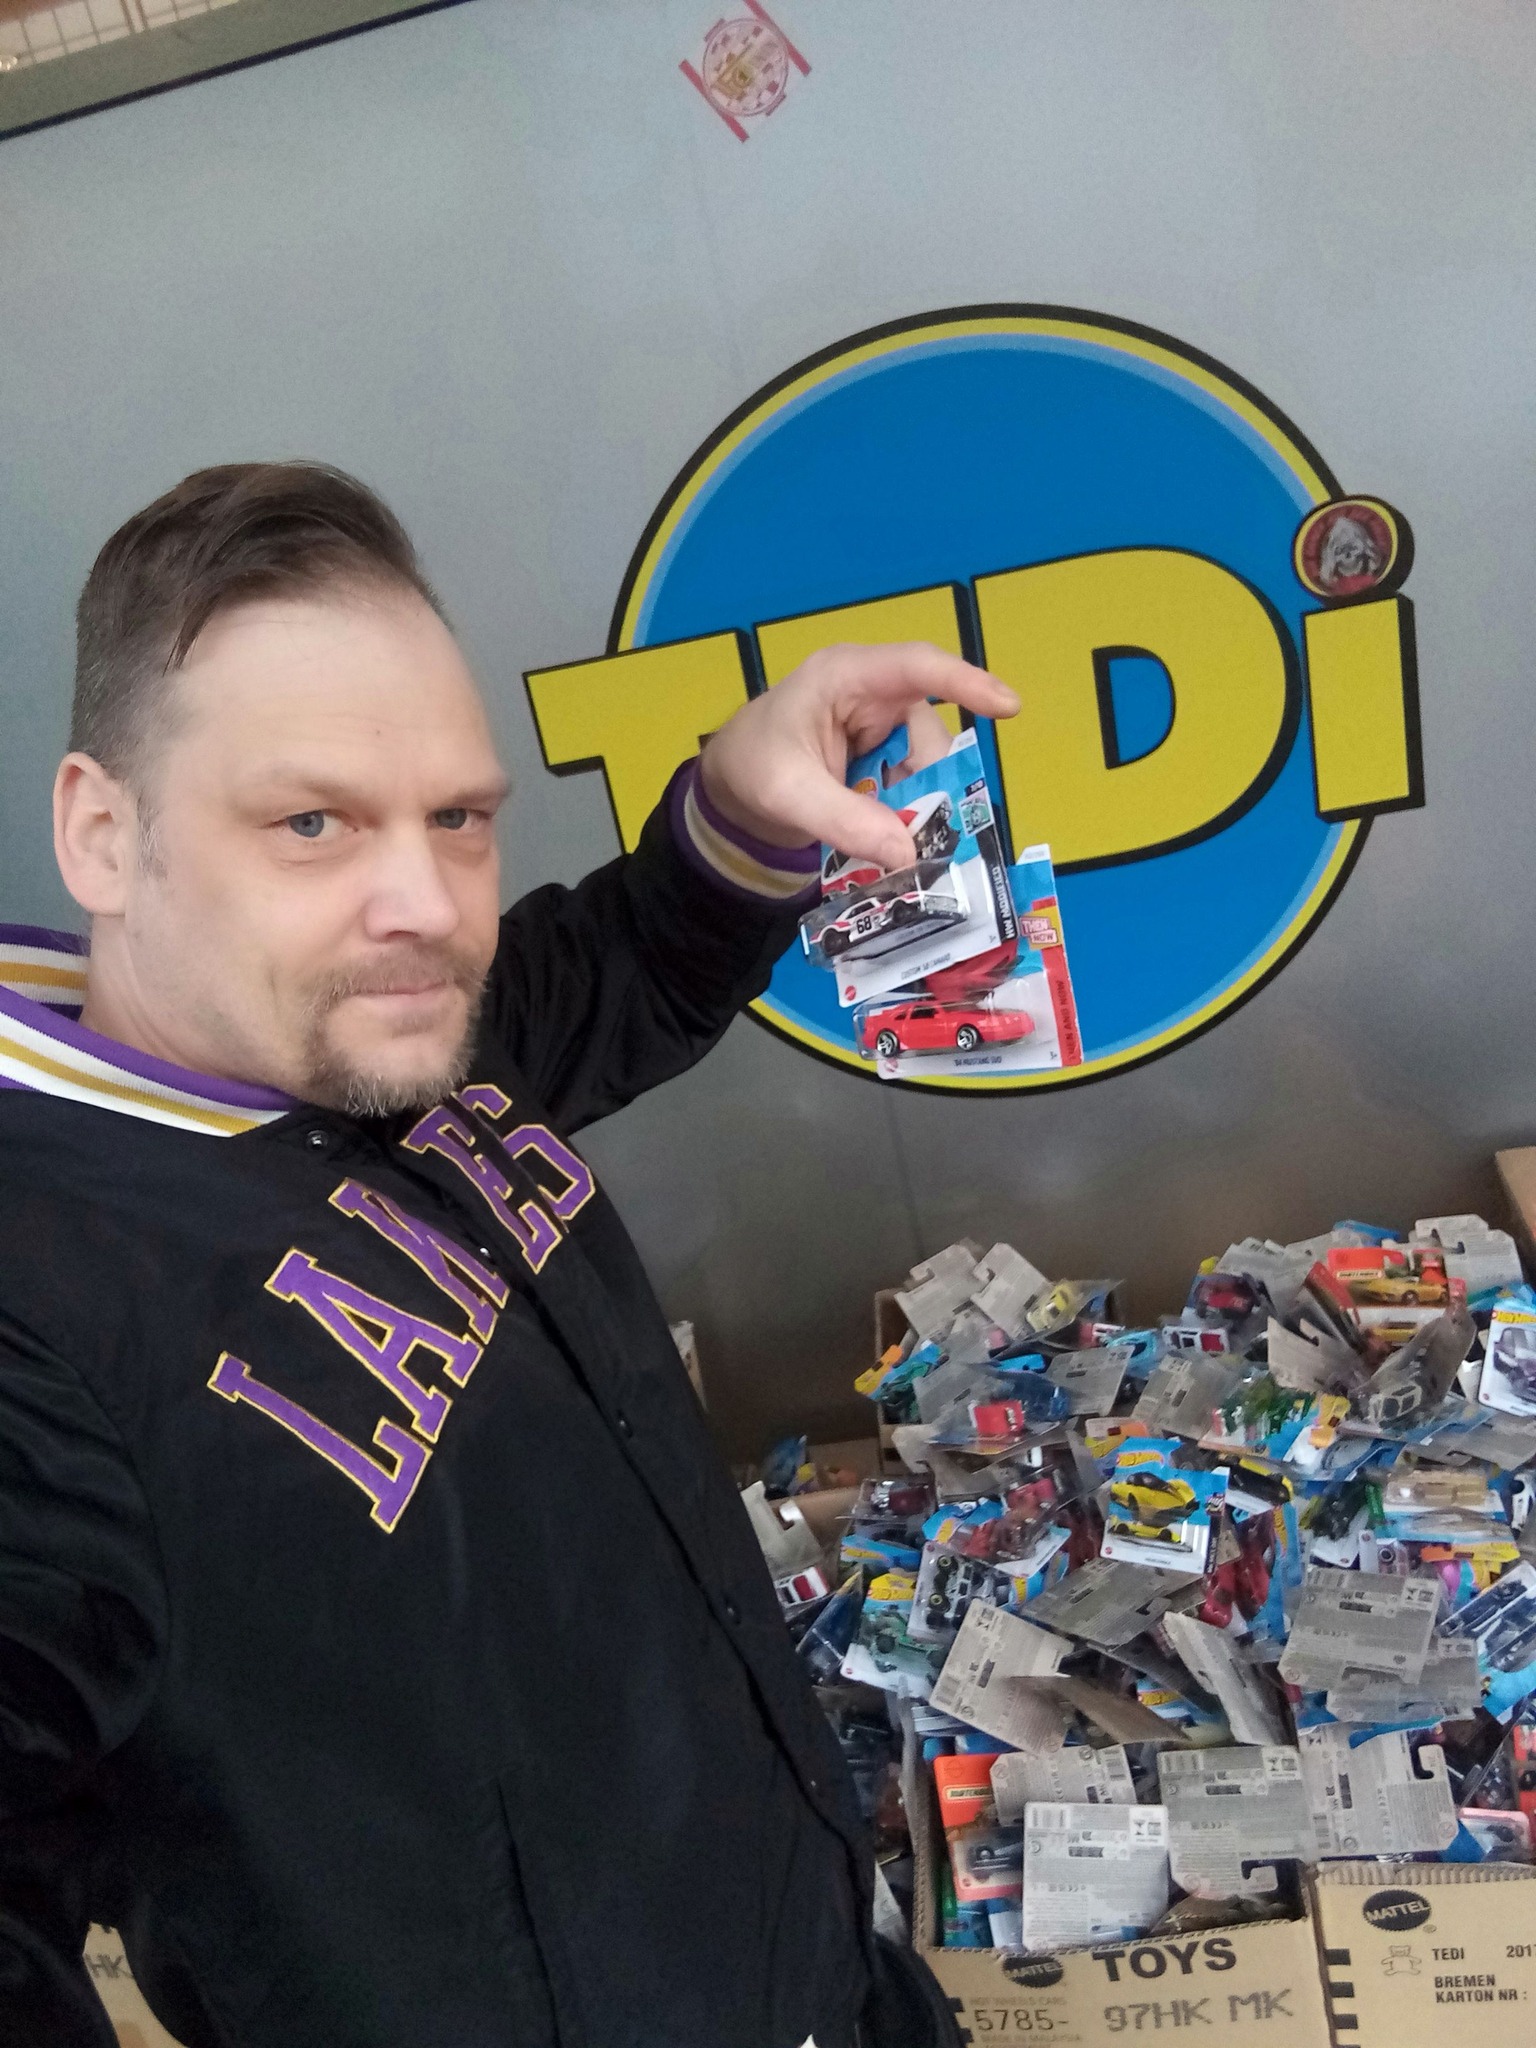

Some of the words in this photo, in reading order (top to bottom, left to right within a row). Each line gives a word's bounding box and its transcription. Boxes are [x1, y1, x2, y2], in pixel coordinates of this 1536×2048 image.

[992, 865, 1011, 918] MODIFIED
[856, 915, 872, 934] 68
[1003, 917, 1016, 940] HW
[1364, 1899, 1431, 1922] MATTEL
[1091, 1937, 1237, 1982] TOYS
[1431, 1947, 1465, 1961] TEDI
[1506, 1943, 1536, 1958] 201
[1004, 1960, 1064, 1979] MATTEL
[1434, 1974, 1496, 1989] BREMEN
[1435, 1989, 1494, 2003] KARTON
[1498, 1988, 1518, 2001] NR
[973, 2008, 1070, 2032] 5785-
[1103, 1997, 1213, 2033] 97HK
[1227, 1988, 1294, 2022] MK
